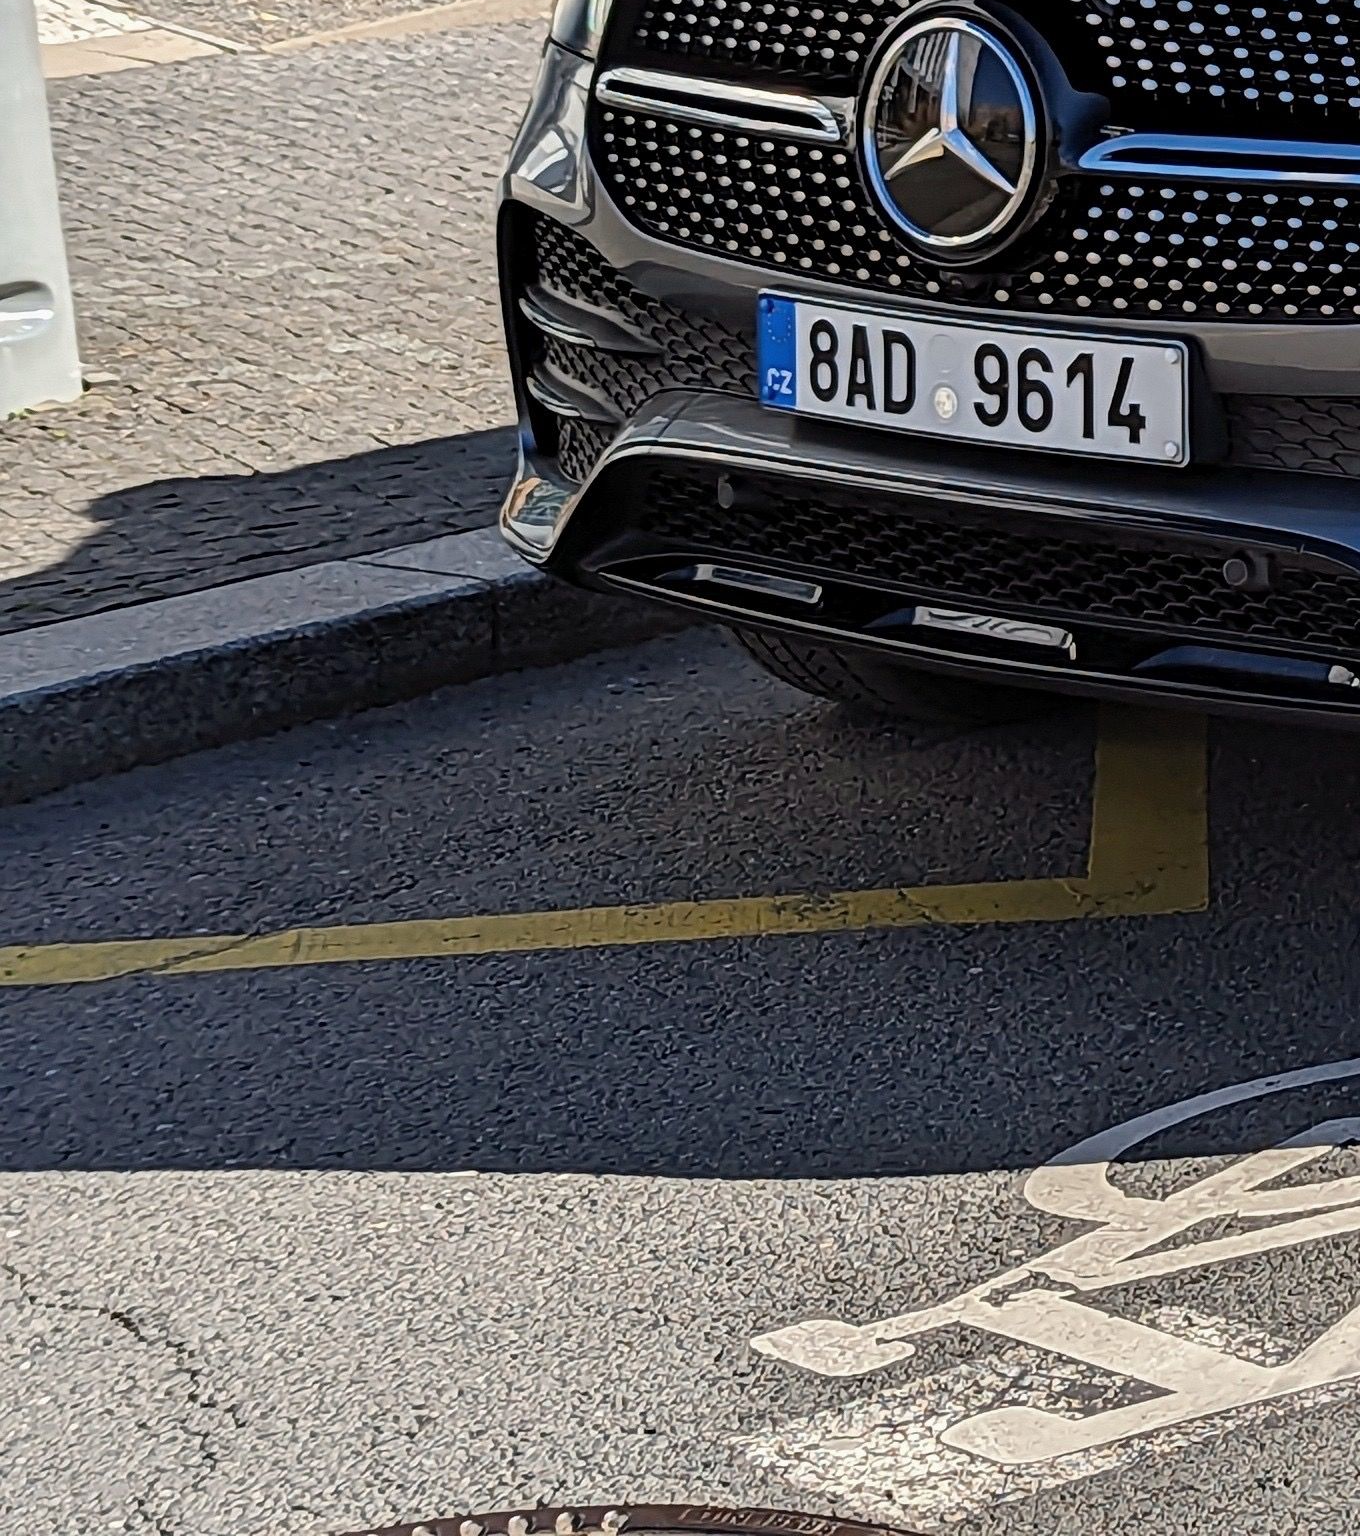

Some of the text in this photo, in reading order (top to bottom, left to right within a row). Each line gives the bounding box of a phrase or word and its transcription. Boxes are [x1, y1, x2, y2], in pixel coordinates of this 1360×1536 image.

[765, 367, 793, 395] CZ
[809, 318, 1147, 444] 8AD 9614
